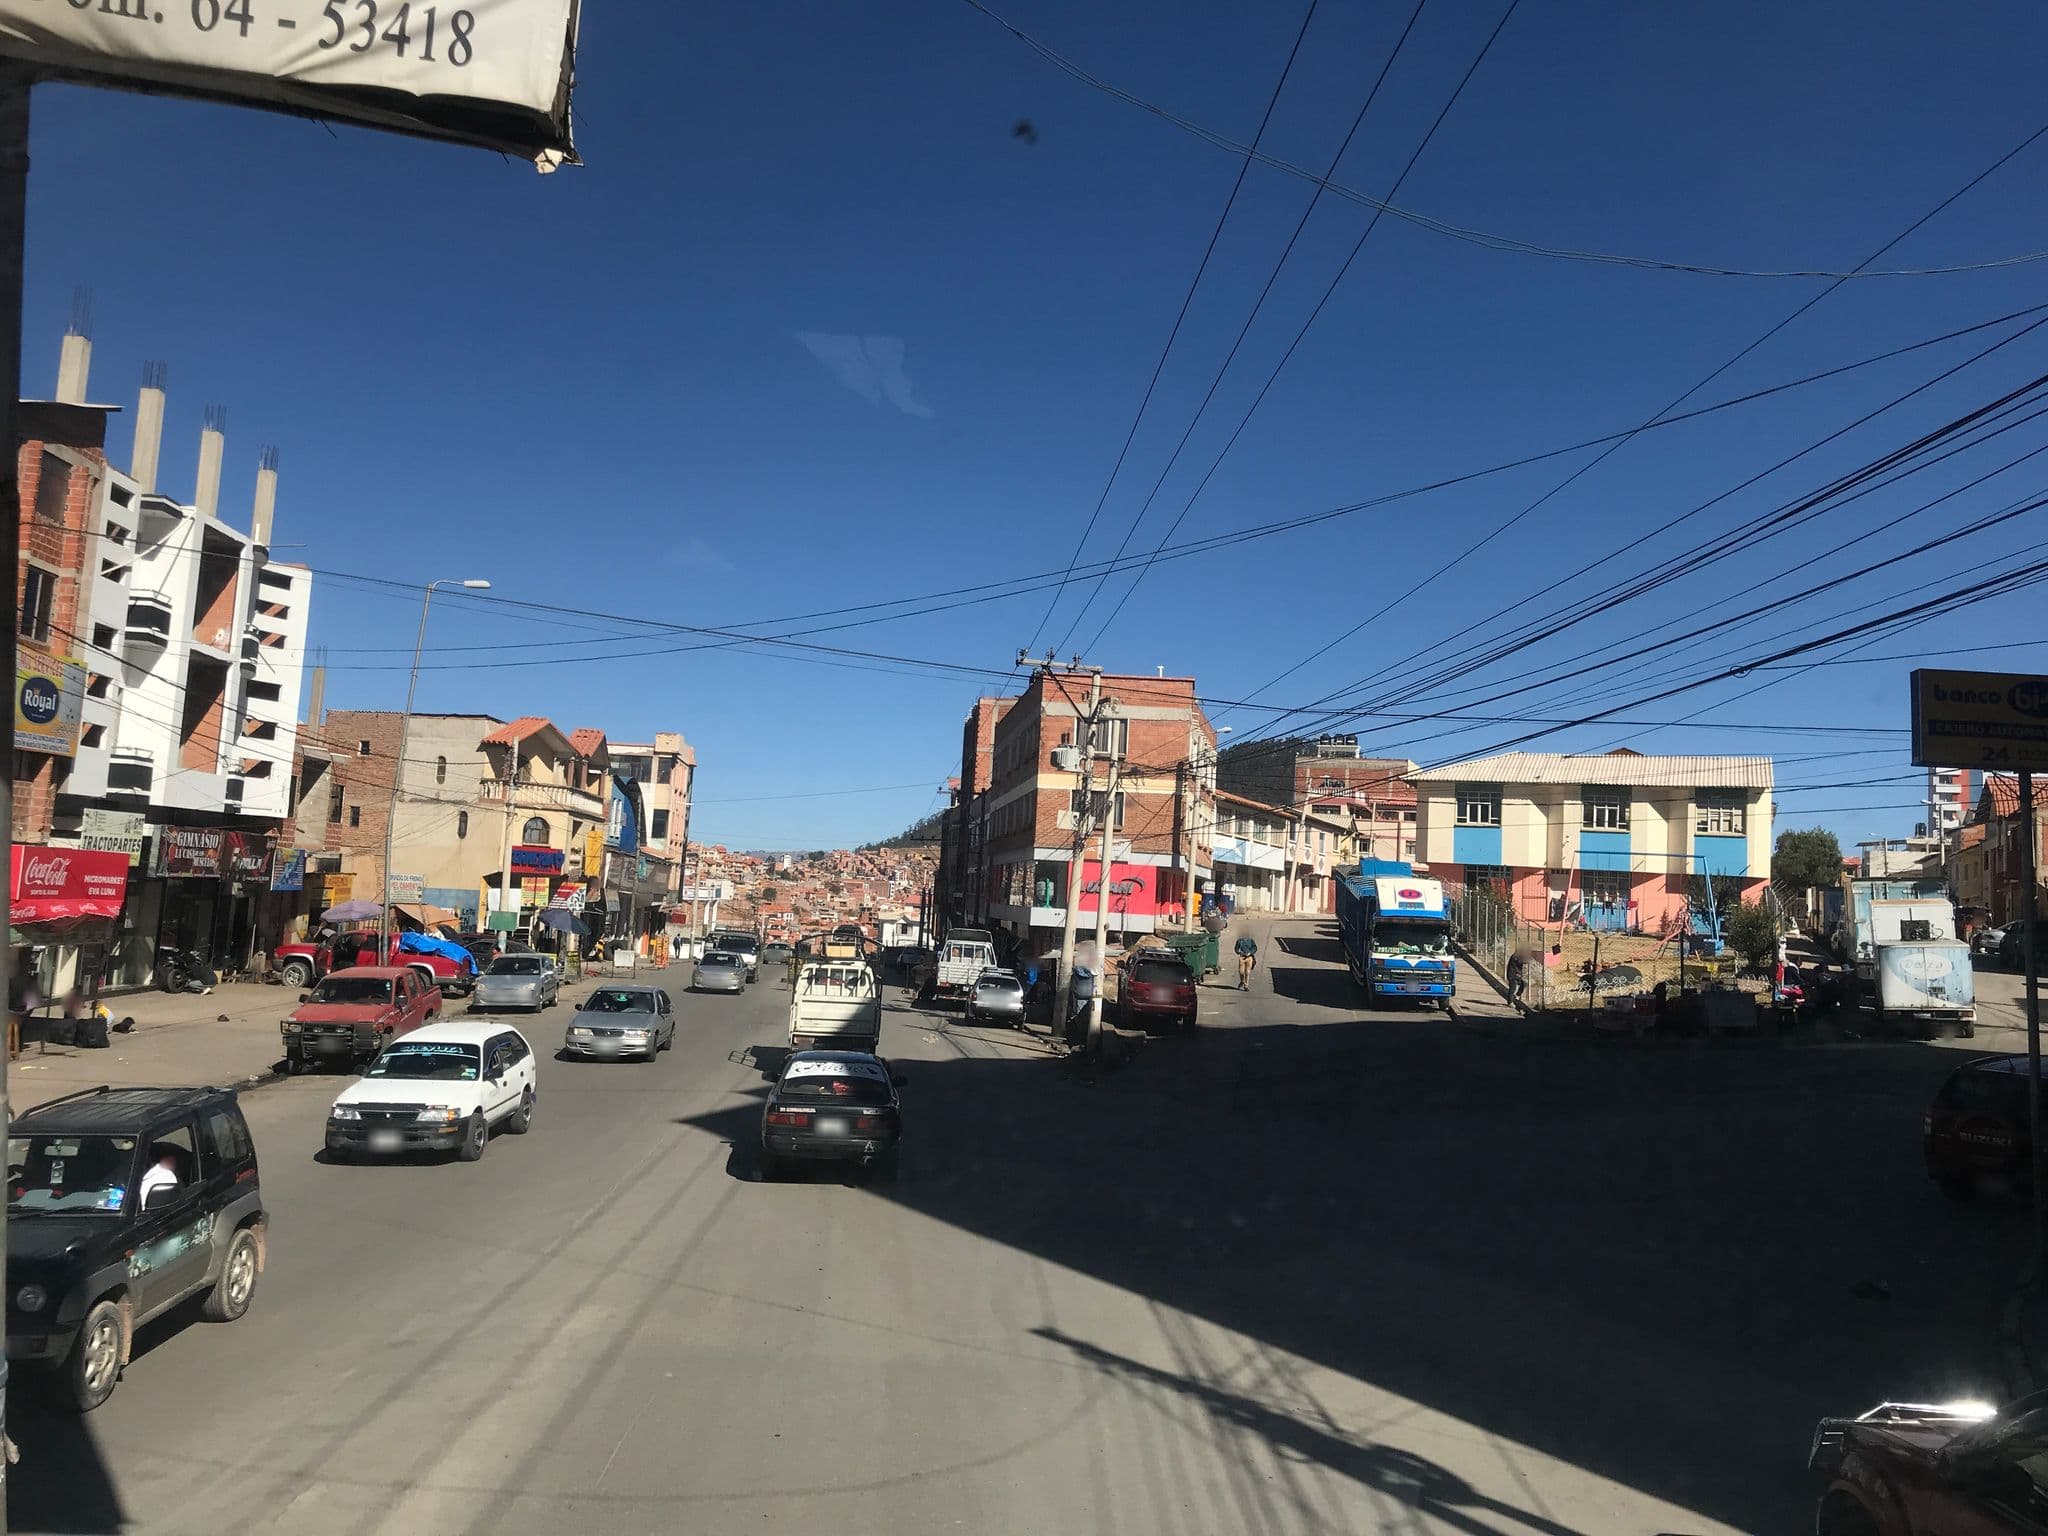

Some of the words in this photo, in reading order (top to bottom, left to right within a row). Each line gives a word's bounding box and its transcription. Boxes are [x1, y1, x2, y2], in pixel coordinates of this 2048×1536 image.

[318, 0, 475, 67] 53418
[25, 689, 57, 712] Royal
[1934, 684, 2002, 704] banco
[83, 835, 141, 853] TRACTOPARTES
[177, 832, 219, 848] GIMNASIO
[84, 875, 125, 885] MICROMARKET
[88, 887, 99, 895] EVA
[100, 888, 116, 896] LUNA
[1959, 1131, 2012, 1145] SUZUKI
